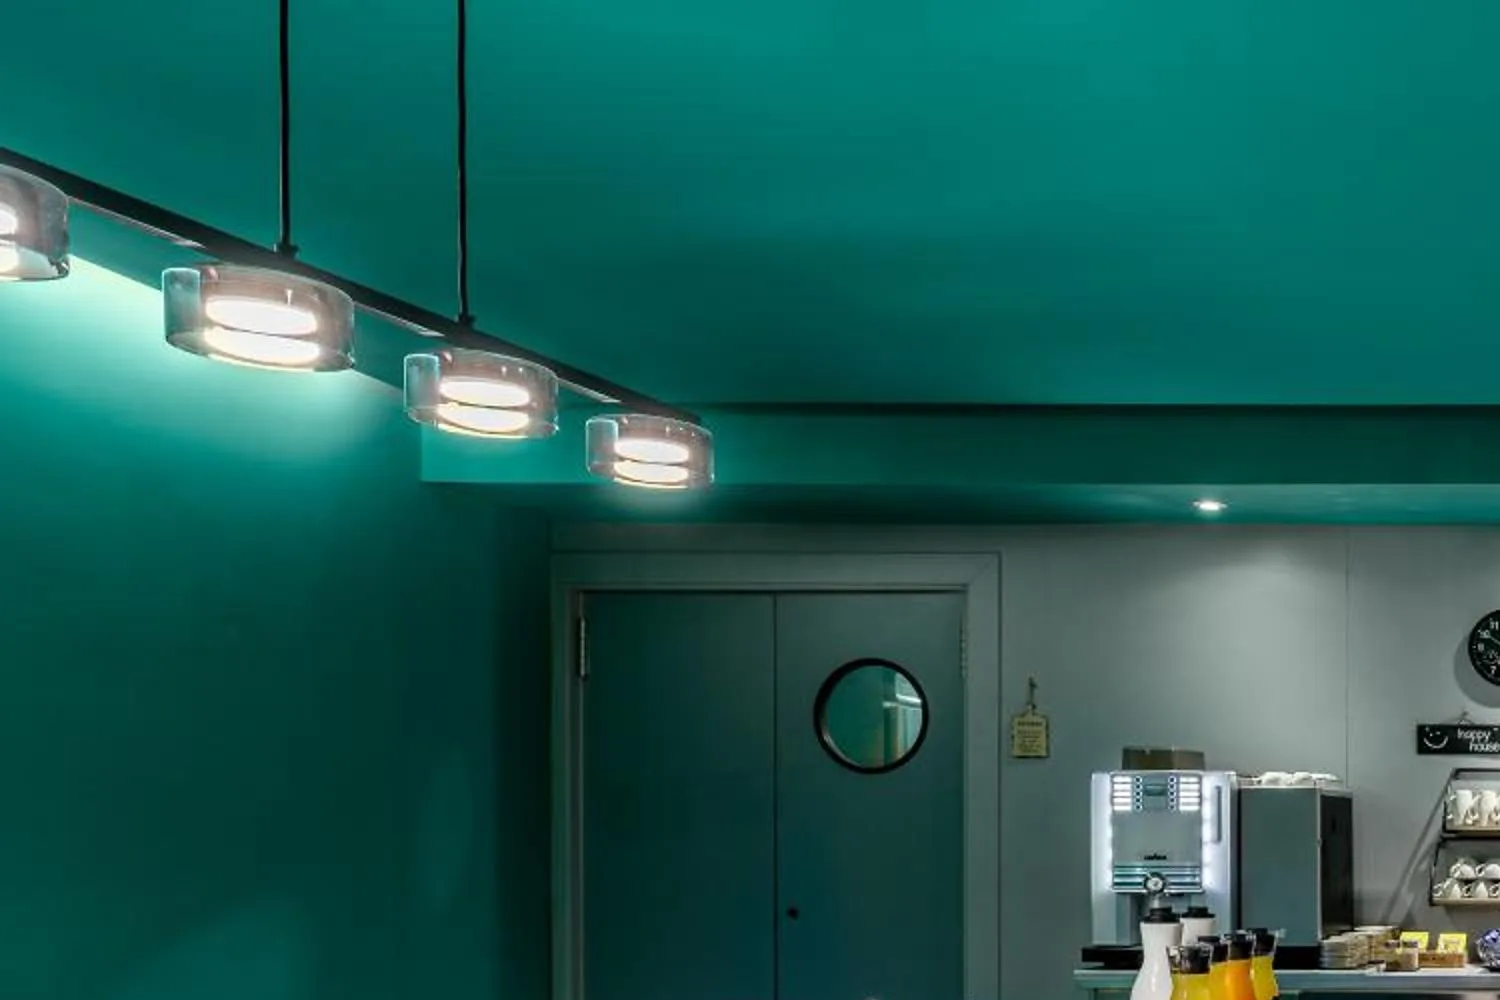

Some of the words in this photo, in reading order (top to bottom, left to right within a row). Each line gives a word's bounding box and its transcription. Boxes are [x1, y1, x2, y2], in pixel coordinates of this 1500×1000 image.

[1490, 666, 1497, 675] 7
[1457, 728, 1491, 742] happy
[1469, 741, 1500, 752] house
